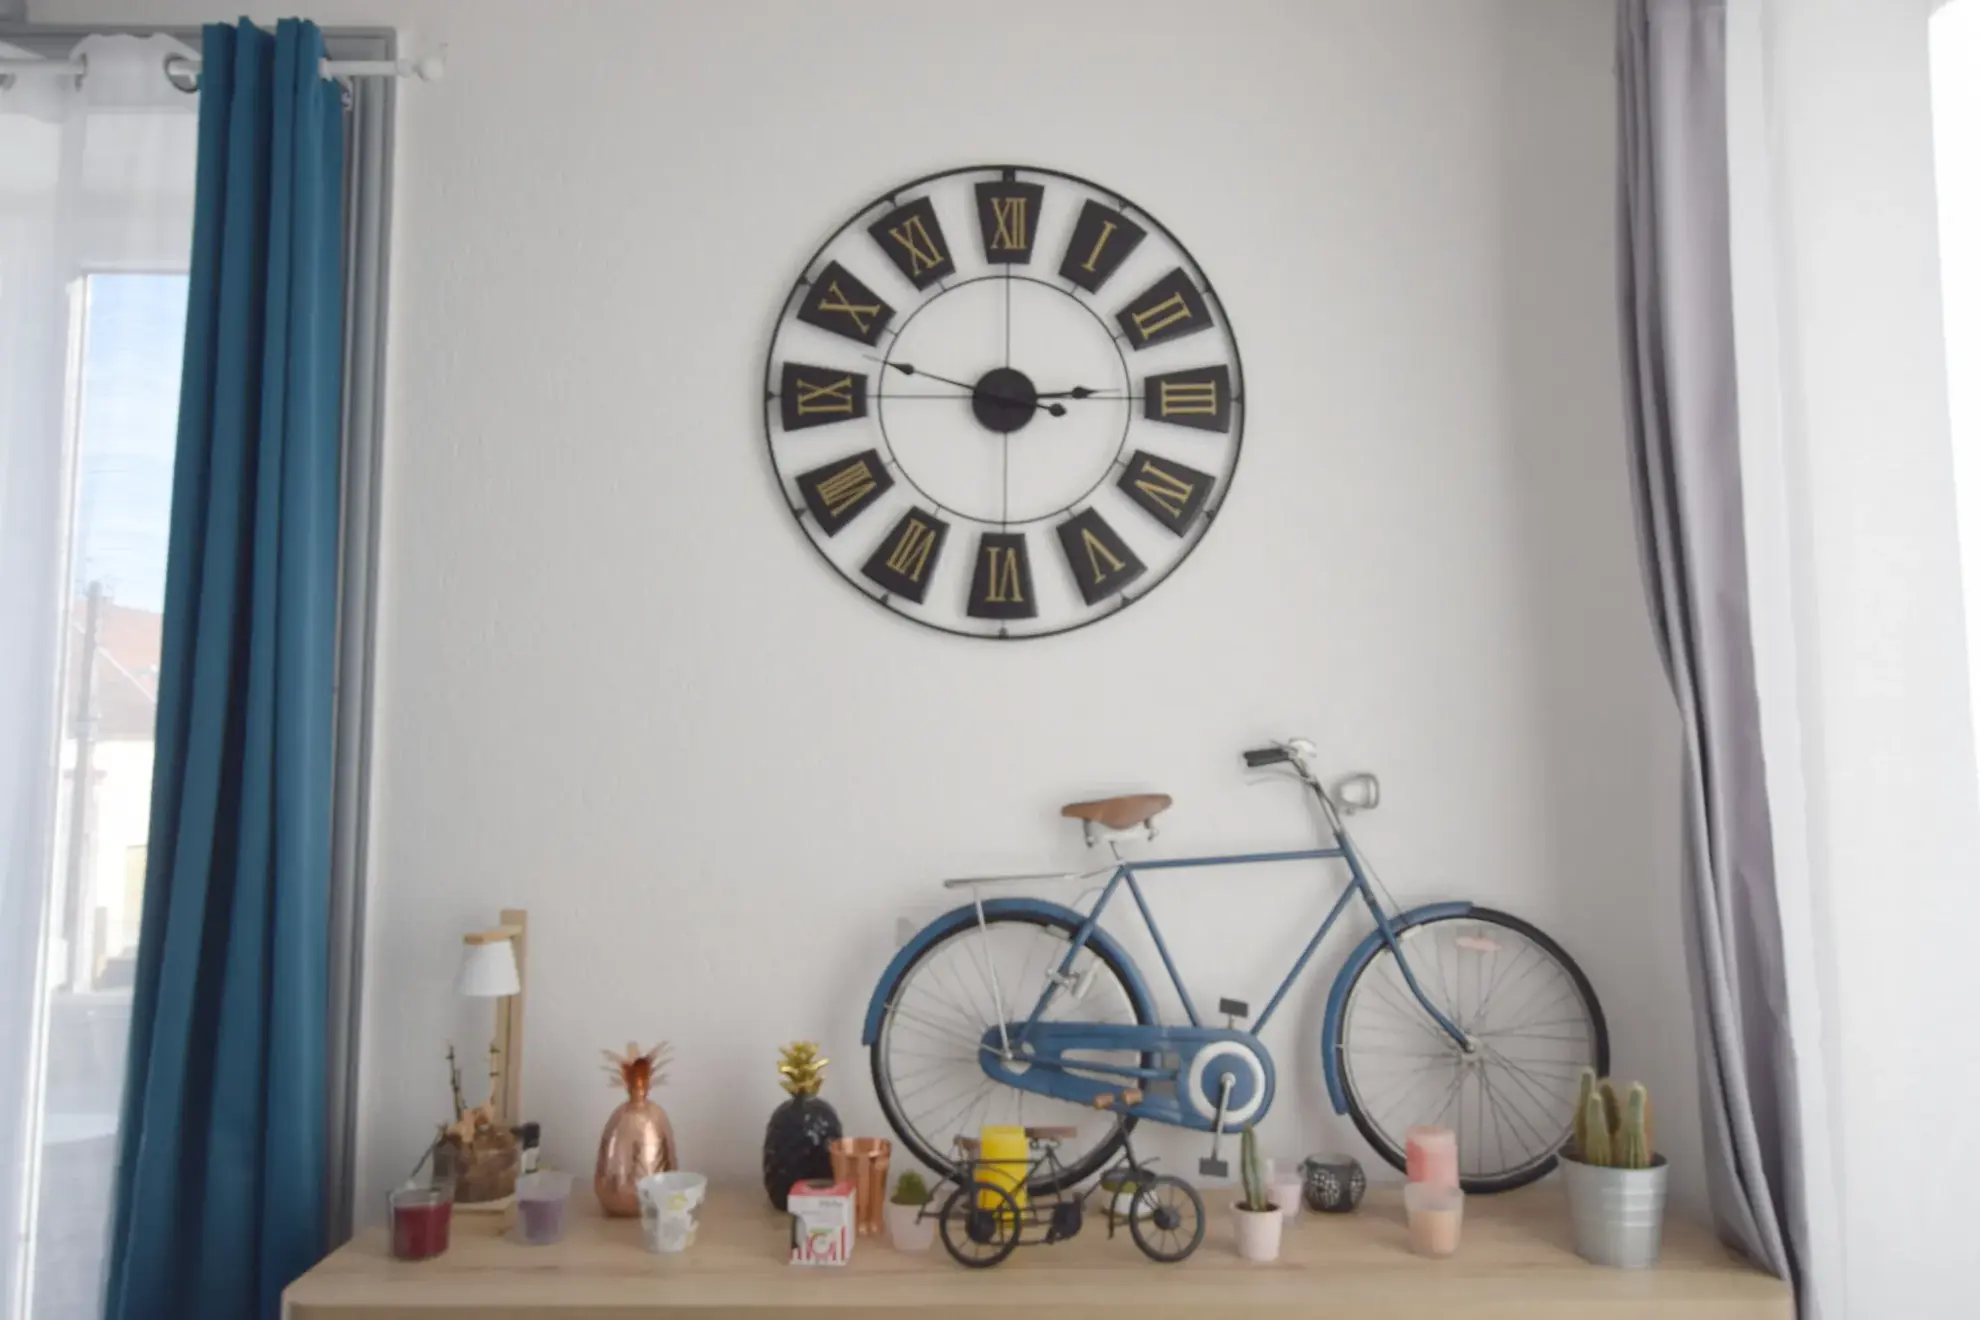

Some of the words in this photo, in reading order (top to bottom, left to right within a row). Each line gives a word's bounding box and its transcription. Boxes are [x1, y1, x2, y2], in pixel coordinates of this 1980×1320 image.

[889, 215, 945, 275] XI
[990, 197, 1027, 251] XII
[1081, 221, 1117, 272] I
[819, 281, 881, 334] X
[1132, 292, 1192, 340] II
[796, 377, 853, 416] IX
[1160, 380, 1217, 416] III
[815, 460, 876, 517] VIII
[1134, 461, 1193, 519] IV
[885, 518, 936, 582] VII
[985, 546, 1023, 603] VI
[1080, 527, 1126, 585] V
